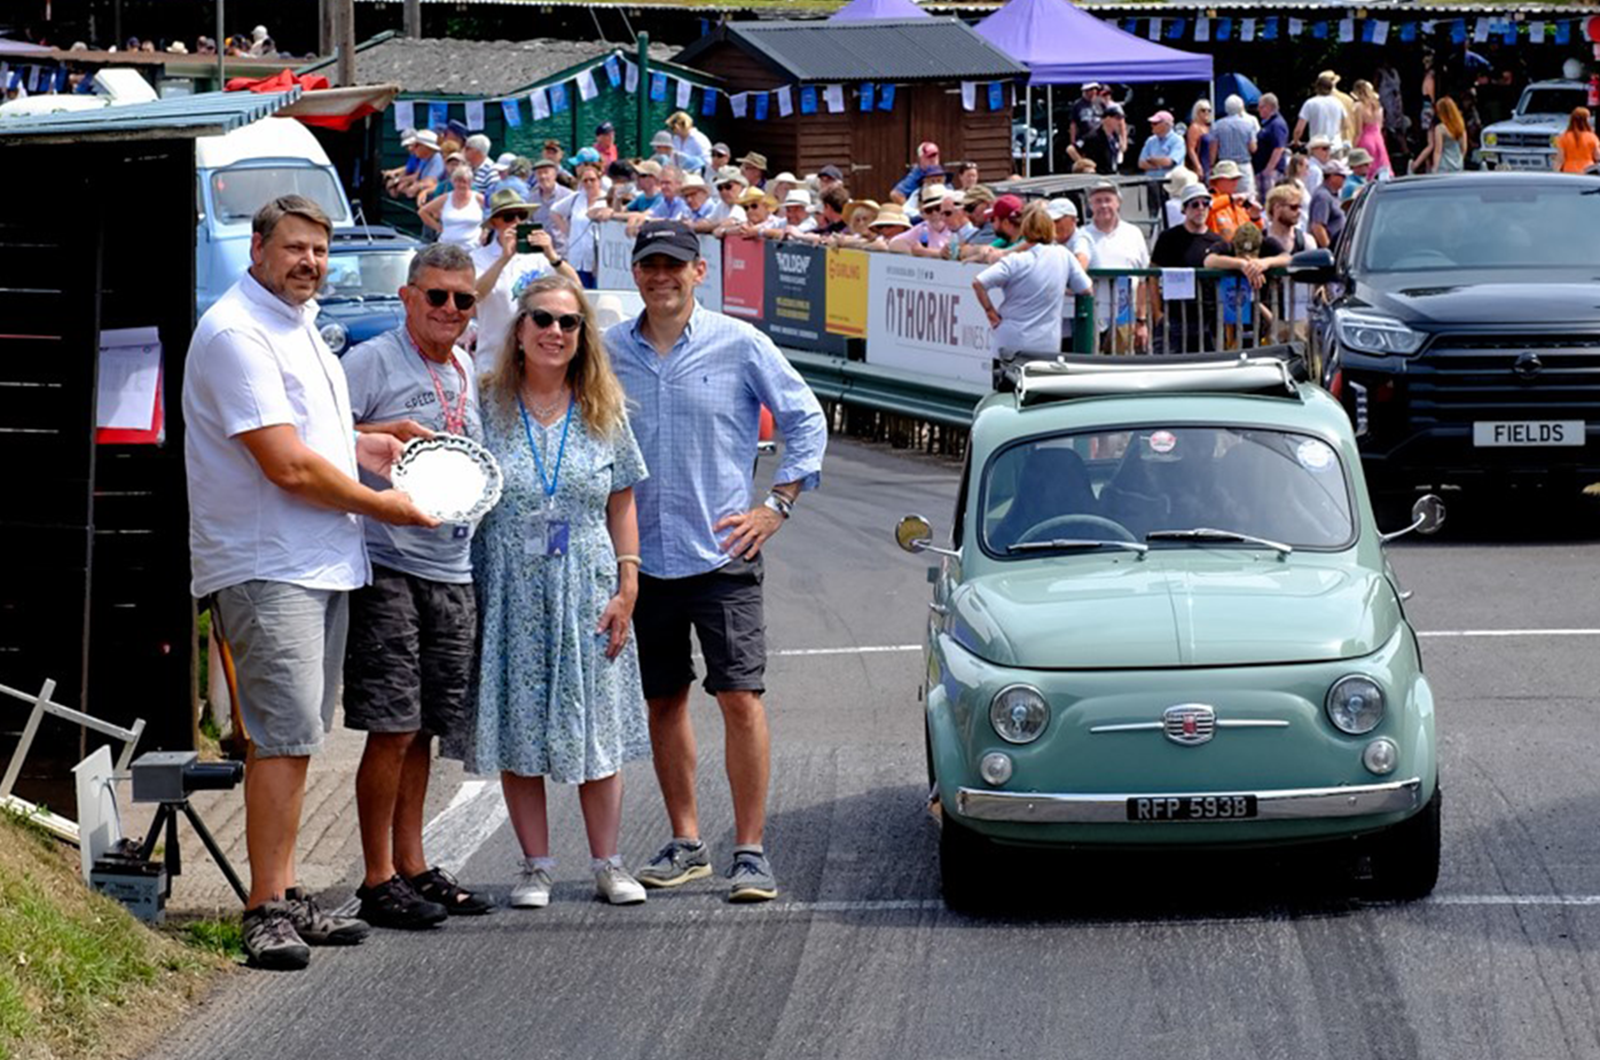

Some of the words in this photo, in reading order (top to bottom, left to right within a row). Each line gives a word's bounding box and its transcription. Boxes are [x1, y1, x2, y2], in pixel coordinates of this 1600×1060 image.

[775, 252, 811, 273] HOLDEN
[405, 391, 435, 409] SPEED
[1494, 423, 1564, 443] FIELDS
[1137, 798, 1180, 819] RFP
[1189, 796, 1247, 818] 593B
